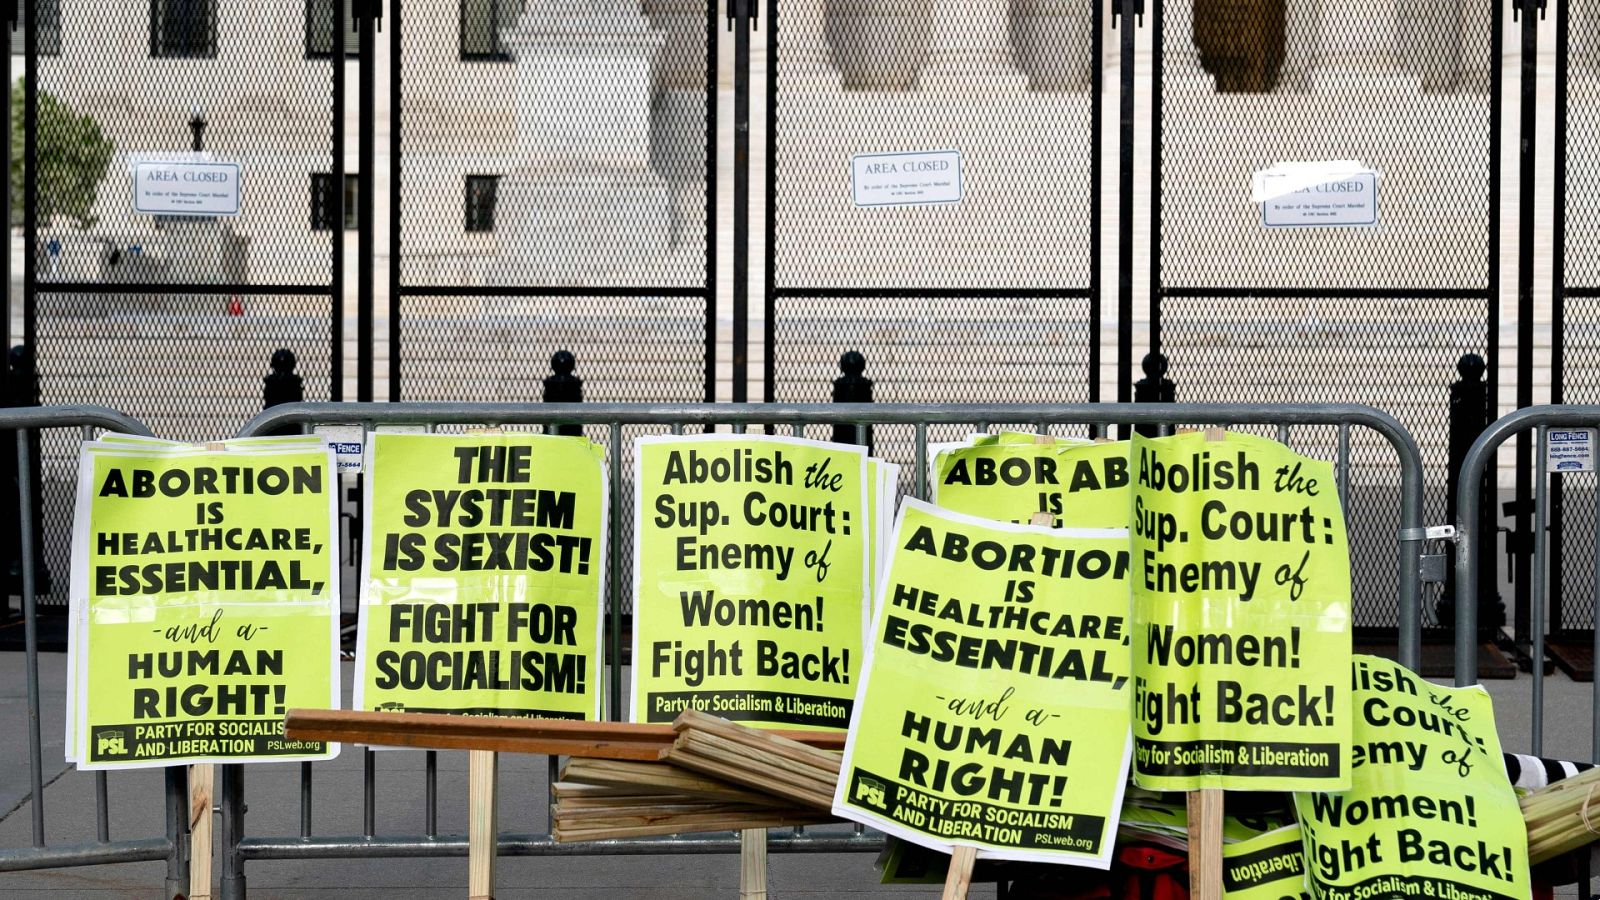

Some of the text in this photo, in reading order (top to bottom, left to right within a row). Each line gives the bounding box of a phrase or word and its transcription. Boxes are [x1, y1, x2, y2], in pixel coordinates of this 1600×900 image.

[147, 171, 228, 183] AREA CLOSED
[865, 161, 949, 174] AREA CLOSED
[1316, 182, 1364, 193] CLOSED
[338, 444, 360, 453] FENCE
[454, 446, 532, 484] THE
[99, 466, 322, 498] ABORTION
[663, 449, 843, 492] Abolish the
[944, 457, 1060, 487] ABOR
[1138, 446, 1260, 494] Abolish
[1274, 462, 1320, 497] the
[196, 502, 224, 525] IS
[404, 489, 576, 530] SYSTEM
[655, 491, 851, 536] Sup. Court:
[1039, 493, 1063, 516] IS
[1135, 494, 1334, 553] Sup. Court:
[98, 528, 323, 556] HEALTHCARE,
[383, 533, 592, 576] IS SEXIST!
[676, 536, 832, 583] Enemy of
[96, 560, 325, 596] ESSENTIAL,
[1004, 580, 1035, 603] IS
[1143, 549, 1311, 602] Enemy of
[389, 603, 577, 646] FIGHT FOR
[680, 590, 824, 632] Women!
[892, 583, 1130, 646] HEALTHCARE,
[652, 640, 850, 687] Fight Back!
[883, 615, 1129, 690] ESSENTIAL,
[1147, 622, 1301, 669] Women!
[128, 650, 283, 680] HUMAN
[375, 650, 587, 695] SOCIALISM!
[133, 684, 287, 720] RIGHT!
[656, 694, 846, 719] Party for Socialism & Liberation
[1135, 676, 1335, 736] Fight Back!
[1352, 661, 1471, 722] lish the
[98, 738, 128, 756] PSL
[135, 721, 284, 740] PARTY FOR SOCIALIS
[135, 740, 320, 757] AND LIBERATION PSLweb.org
[901, 710, 1072, 766] HUMAN
[1151, 745, 1171, 765] for
[1174, 743, 1235, 766] Socialism
[1238, 746, 1249, 766] &
[1253, 746, 1329, 767] Liberation
[1352, 742, 1474, 778] emy of
[899, 747, 1068, 807] RIGHT!
[856, 783, 887, 810] PSL
[896, 787, 1074, 831] PARTY FOR SOCIALISM
[1312, 792, 1477, 828] Women!
[893, 805, 1093, 851] AND LIBERATION PSLweb.org
[1397, 828, 1514, 883] Back!
[1354, 877, 1420, 900] Socialism
[1424, 880, 1435, 897] &
